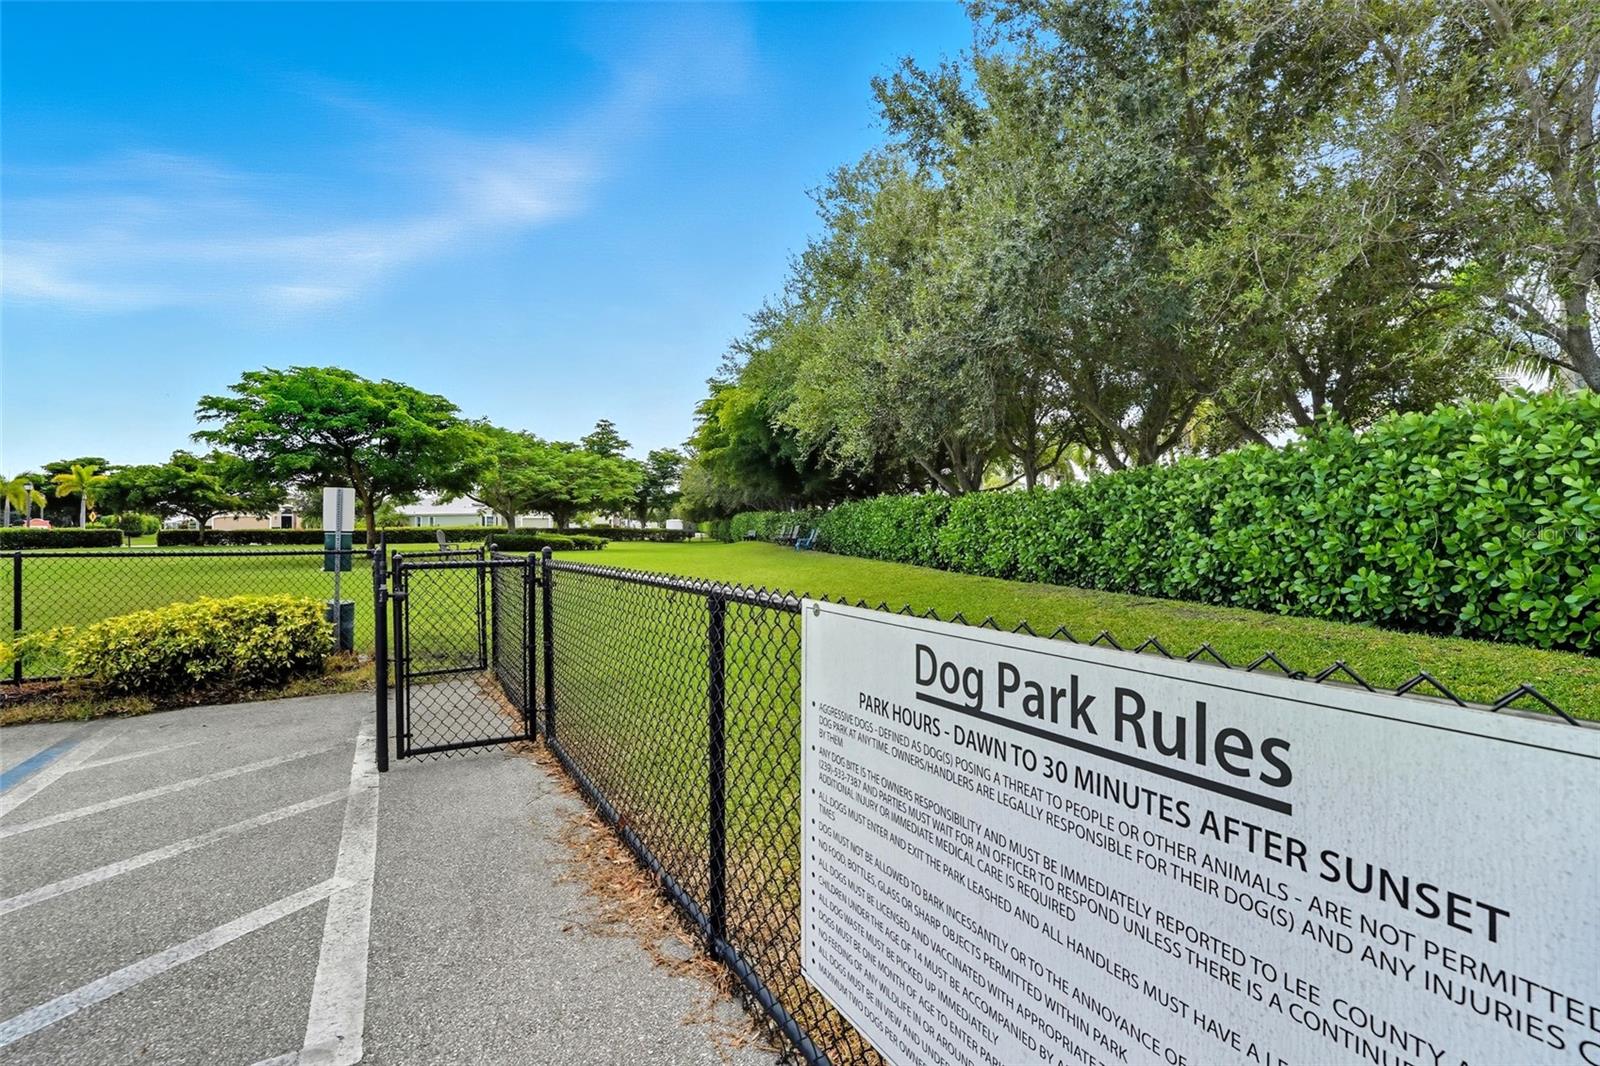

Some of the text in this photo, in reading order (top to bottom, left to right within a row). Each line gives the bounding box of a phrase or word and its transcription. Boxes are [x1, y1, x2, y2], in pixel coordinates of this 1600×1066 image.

[916, 643, 1293, 788] Dog Park Rules
[818, 803, 835, 821] TIMES
[818, 703, 853, 725] AGGRESSIVE
[854, 716, 873, 733] DOGS
[878, 726, 910, 747] DEFINED
[910, 739, 922, 753] AS
[923, 743, 953, 767] DOG(S)
[955, 756, 991, 781] POSING
[992, 771, 1001, 785] A
[1002, 774, 1044, 801] THREAT
[1045, 791, 1062, 809] TO
[1065, 799, 1114, 832] PEOPLE
[1118, 820, 1139, 841] OR
[1143, 830, 1196, 864] OTHER
[1201, 854, 1288, 901] ANIMALS
[1308, 896, 1352, 928] ARE
[1360, 914, 1415, 951] NOT
[859, 692, 1510, 943] PARK HOURS DAWN TO 30 MINUTES AFTER SUNSET
[879, 805, 1075, 921] OR IMMEDIATE MEDICAL CARE IS REQUIRED
[818, 746, 1445, 1066] ANY DOG BITE IS THE OWNERS RESPONSIBILITY AND MUST BE IMMEDIATELY REPORTED TO LEE COUNTY
[847, 807, 866, 825] MUST
[866, 818, 888, 840] ENTER
[889, 832, 906, 850] AND
[907, 842, 924, 861] EXIT
[925, 852, 941, 872] THE
[942, 863, 965, 886] PARK
[967, 878, 1012, 913] LEASHED
[1014, 906, 1039, 929] AND
[1041, 922, 1063, 945] ALL
[1066, 936, 1139, 989] HANDLERS
[1143, 980, 1189, 1018] MUST
[1193, 1009, 1240, 1051] HAVE
[1246, 1042, 1259, 1063] A
[847, 858, 1128, 1064] BOTTLES, GLASS OR SHARP OBJECTS PERMITTED WITHIN PARK
[850, 841, 864, 857] NOT
[864, 850, 873, 865] BE
[874, 858, 910, 888] ALLOWED
[910, 880, 921, 896] TO
[922, 888, 944, 912] BARK
[946, 904, 1008, 952] INCESSANTLY
[1010, 946, 1026, 967] OR
[1027, 956, 1044, 977] TO
[1045, 968, 1069, 995] THE
[1072, 987, 1160, 1055] ANNOYANCE
[862, 782, 878, 798] AND
[878, 789, 907, 813] PARTIES
[908, 805, 931, 825] MUST
[931, 818, 953, 837] WAIT
[955, 829, 974, 849] FOR
[975, 841, 990, 858] AN
[992, 849, 1036, 882] OFFICER
[1037, 871, 1054, 891] TO
[1057, 882, 1119, 924] RESPOND
[1123, 916, 1181, 958] UNLESS
[1185, 947, 1241, 991] THERE
[1247, 979, 1263, 1001] IS
[1268, 993, 1283, 1013] A
[1289, 1003, 1414, 1066] CONTINU
[866, 892, 875, 907] BE
[875, 900, 910, 932] LICENSED
[911, 926, 929, 946] AND
[930, 939, 986, 987] VACCINATED
[987, 980, 1014, 1010] WITH
[891, 746, 1565, 1049] OWNERS/HANDLERS ARE LEGALLY RESPONSIBLE FOR THEIR DOG(S) AND ANY INJURIES
[843, 912, 998, 1045] WASTE MUST BE PICKED UP IMMEDIATELY
[847, 897, 1054, 1065] UNDER THE AGE OF 14 MUST BE ACCOMPANIED BY
[853, 939, 861, 953] BE
[862, 947, 876, 967] ONE
[877, 960, 905, 990] MONTH
[906, 984, 917, 999] OF
[918, 995, 937, 1017] AGE
[935, 1008, 948, 1027] TO
[949, 1020, 978, 1053] ENTER
[853, 959, 862, 972] OF
[863, 968, 878, 986] ANY
[878, 981, 911, 1017] WILDLIFE
[912, 1010, 921, 1026] IN
[922, 1020, 935, 1038] OR
[864, 1006, 898, 1046] DOGS PER
[865, 988, 874, 1003] BE
[875, 997, 883, 1011] IN
[883, 1004, 902, 1028] VIEW
[902, 1023, 920, 1045] AND
